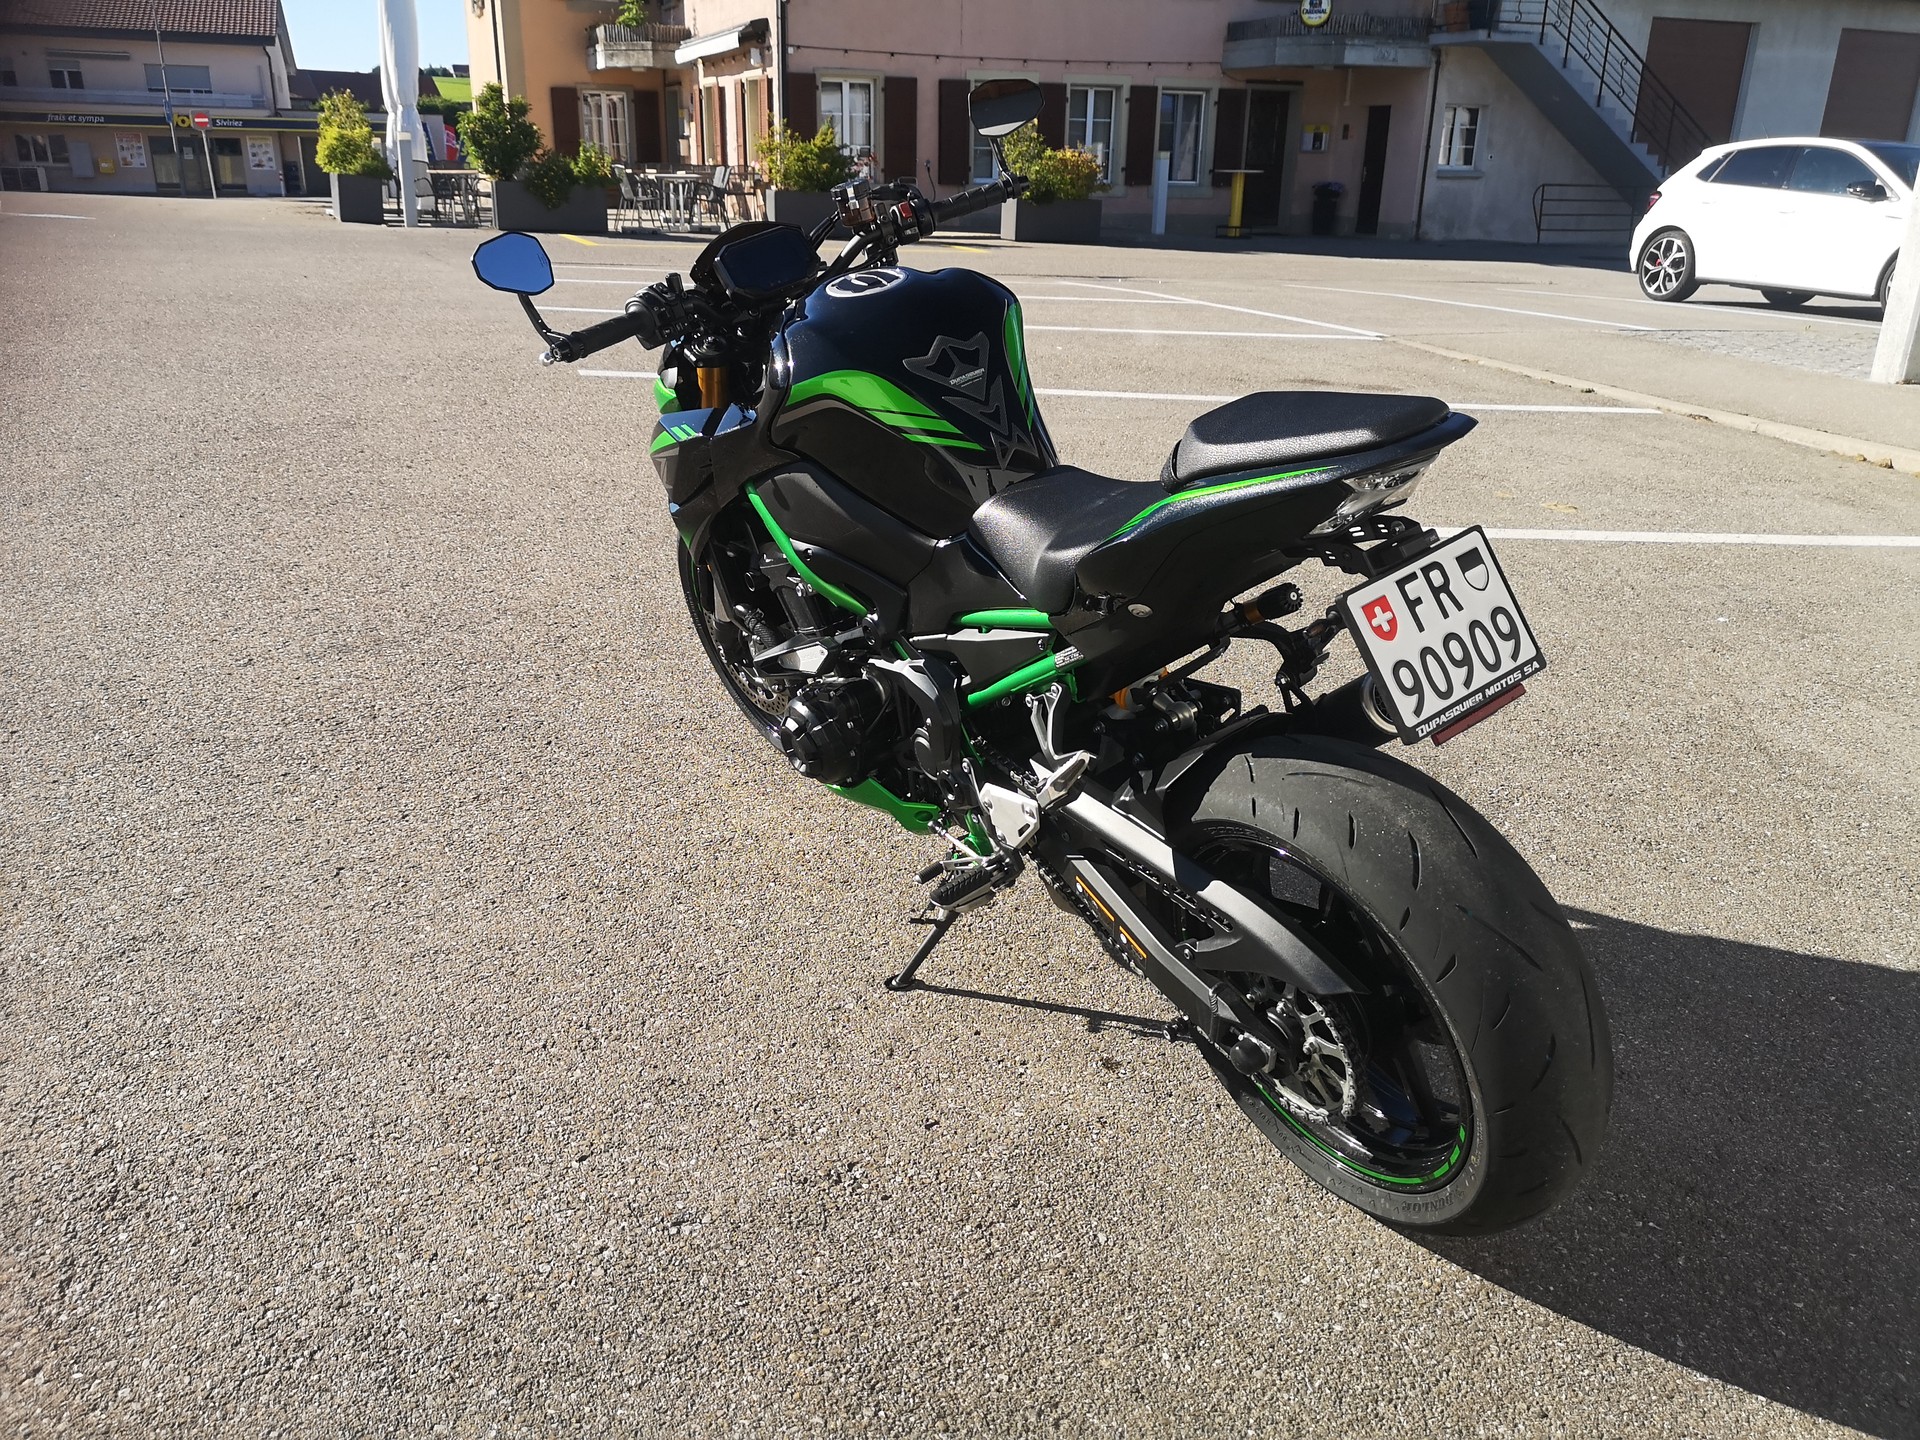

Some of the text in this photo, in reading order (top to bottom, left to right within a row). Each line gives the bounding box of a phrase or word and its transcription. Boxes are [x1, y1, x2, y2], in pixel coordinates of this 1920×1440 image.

[47, 113, 66, 123] frais
[78, 116, 105, 124] sympa
[216, 119, 243, 127] Siviriez
[1395, 561, 1464, 633] FR
[1392, 606, 1522, 718] 90909
[1415, 660, 1541, 738] DUPASQUIER MOTOS SA
